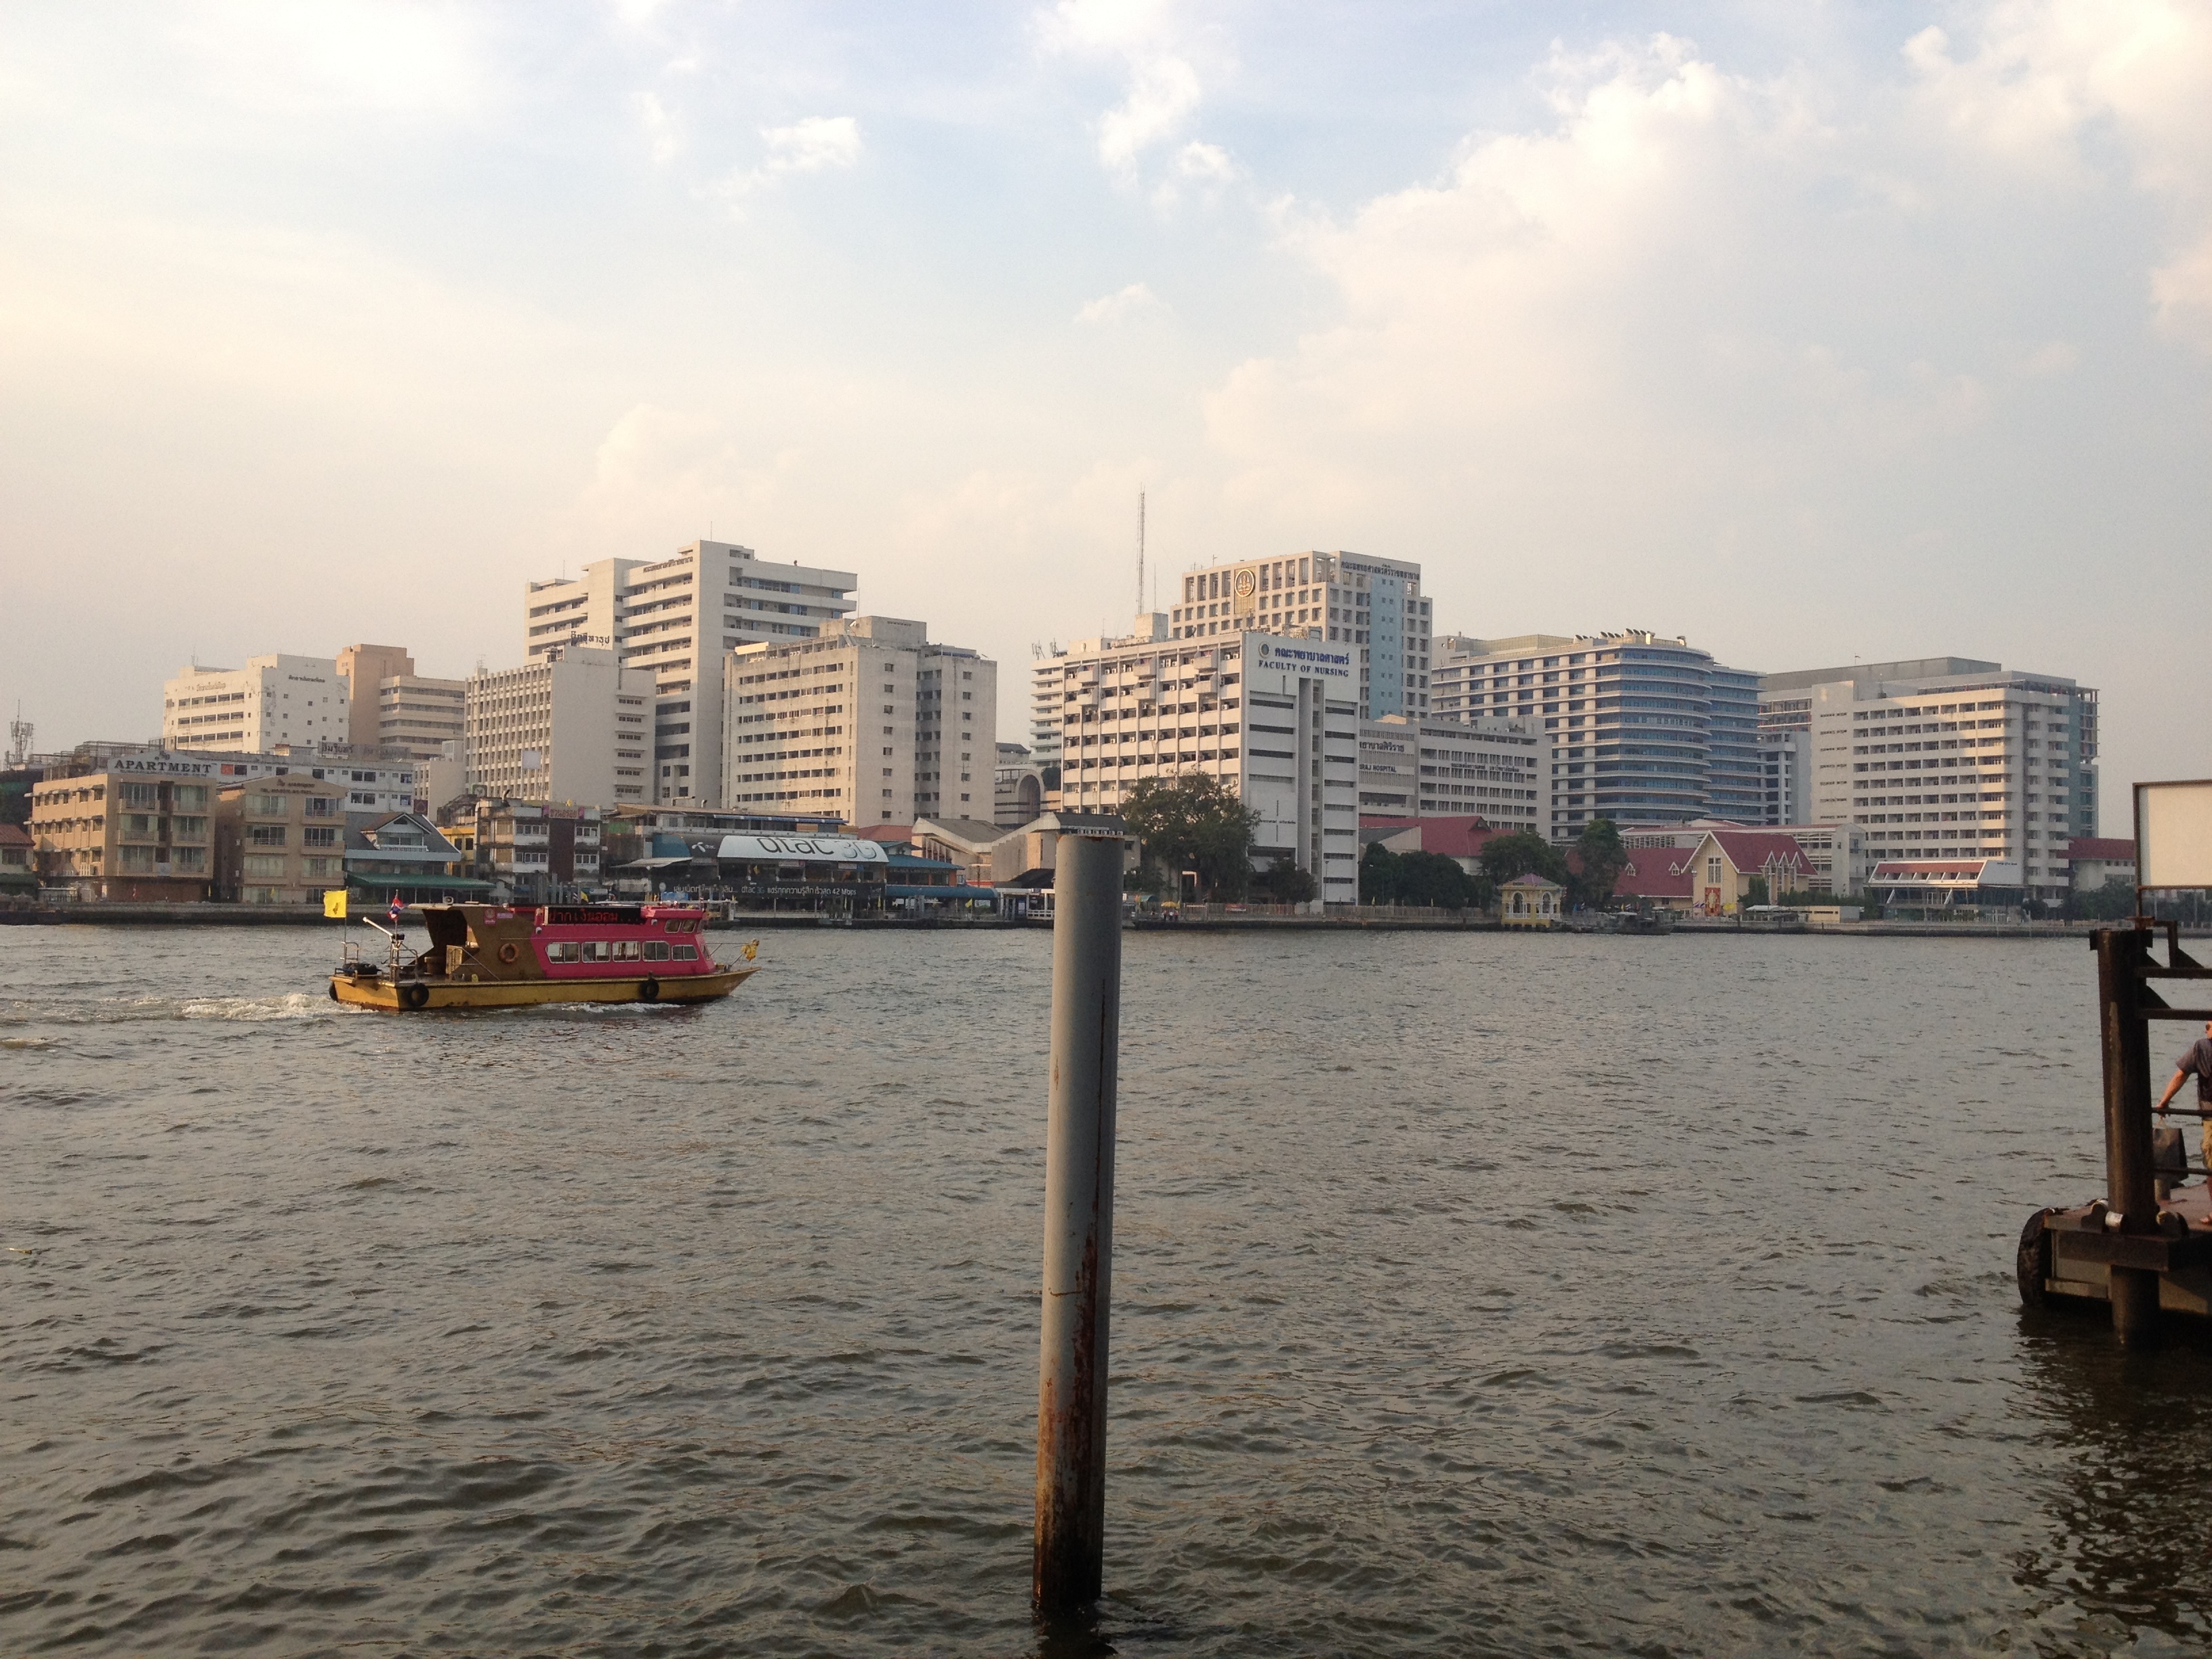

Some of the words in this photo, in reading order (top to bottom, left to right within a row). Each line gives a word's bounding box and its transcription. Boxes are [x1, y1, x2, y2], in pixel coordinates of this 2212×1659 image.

[1275, 647, 1349, 665] คณะพยาบาลศาสตร์
[1258, 660, 1297, 672] FACULTY
[1300, 665, 1311, 673] OF
[1315, 667, 1349, 677] NURSING
[114, 760, 211, 773] APARTMENT
[757, 836, 834, 855] dtac
[839, 840, 877, 859] 3G
